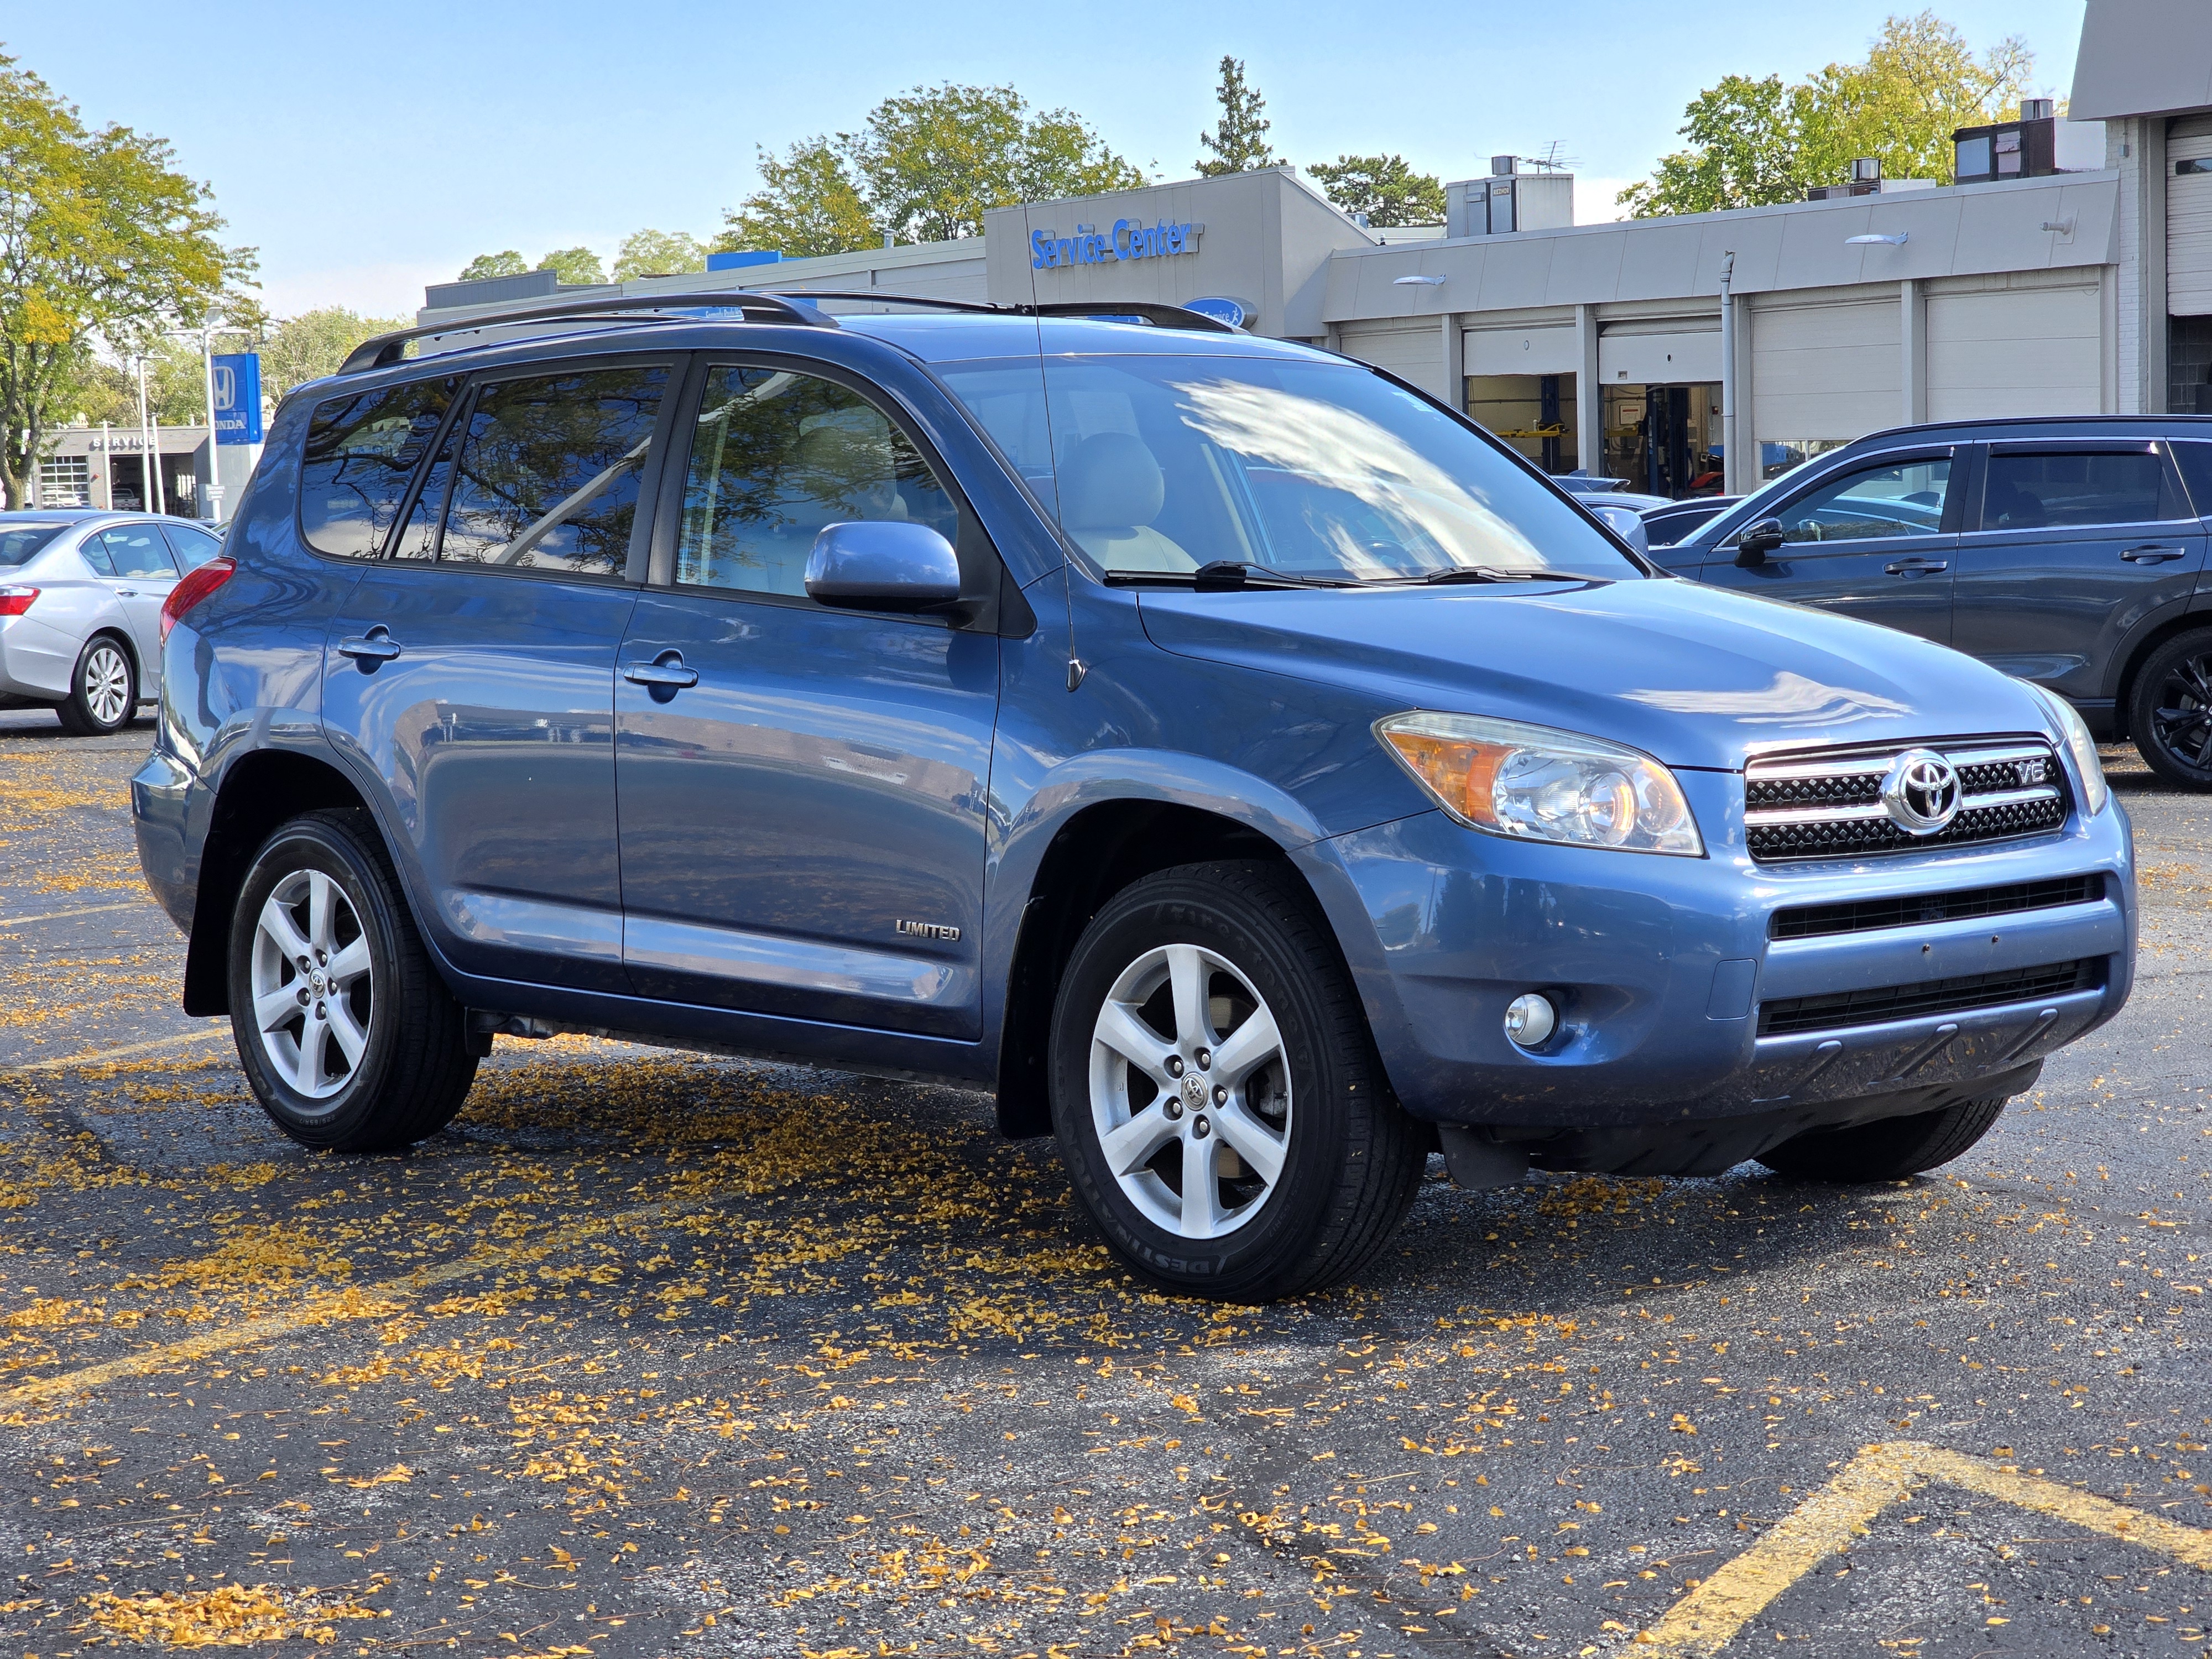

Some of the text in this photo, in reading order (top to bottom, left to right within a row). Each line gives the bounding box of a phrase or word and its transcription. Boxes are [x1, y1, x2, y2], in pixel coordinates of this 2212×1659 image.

[1031, 218, 1192, 269] Service Center
[1205, 310, 1229, 322] vice
[215, 420, 246, 430] ONDA
[93, 436, 155, 447] SRVICE
[2015, 762, 2046, 786] V6
[896, 919, 961, 942] LIMITED
[299, 1114, 336, 1125] 225/65R17
[1061, 1120, 1210, 1274] DESTINATION
